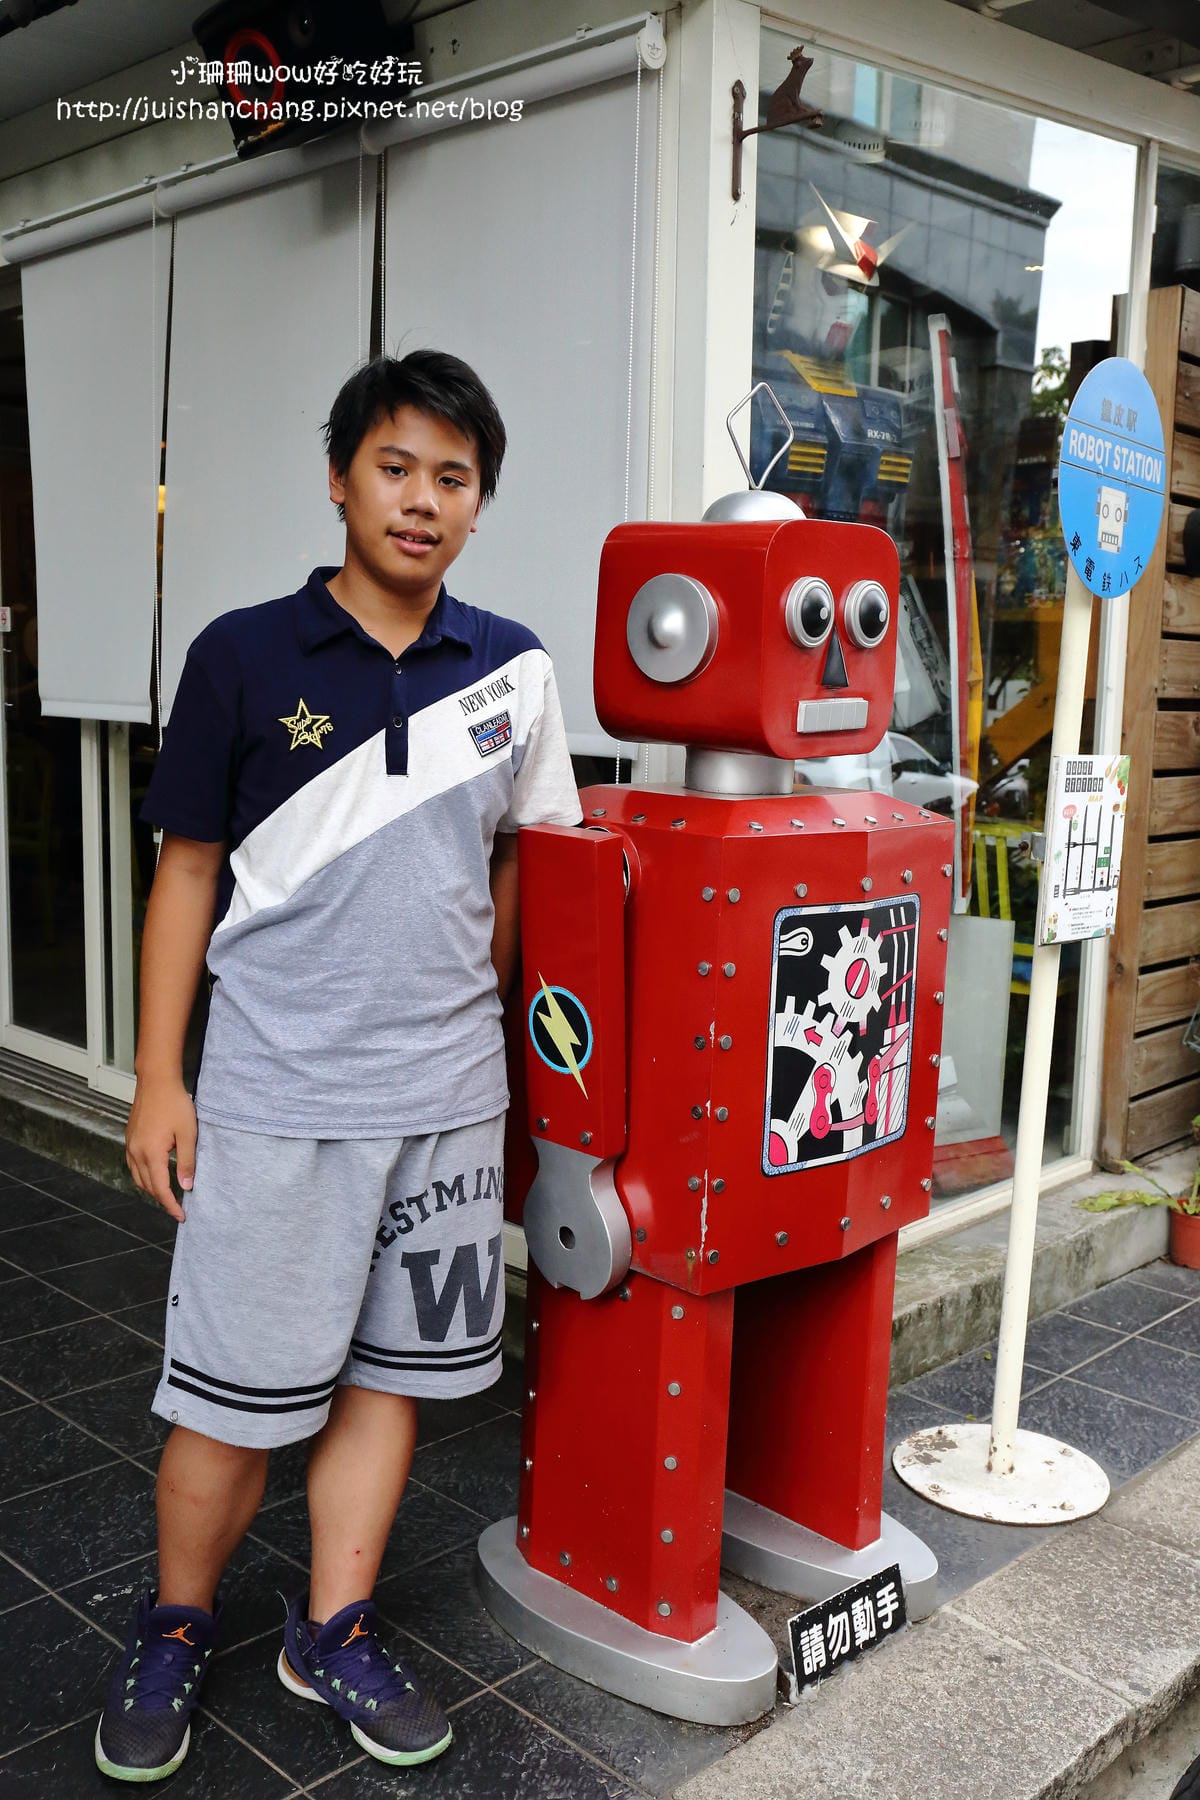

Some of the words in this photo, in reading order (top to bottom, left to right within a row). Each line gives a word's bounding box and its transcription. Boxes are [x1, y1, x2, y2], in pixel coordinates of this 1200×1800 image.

[1069, 428, 1112, 466] ROBOT
[1113, 443, 1162, 486] STATION
[457, 689, 488, 717] NEW
[484, 675, 516, 702] YORK
[400, 1230, 503, 1343] W
[800, 1581, 900, 1676] 請勿動手
